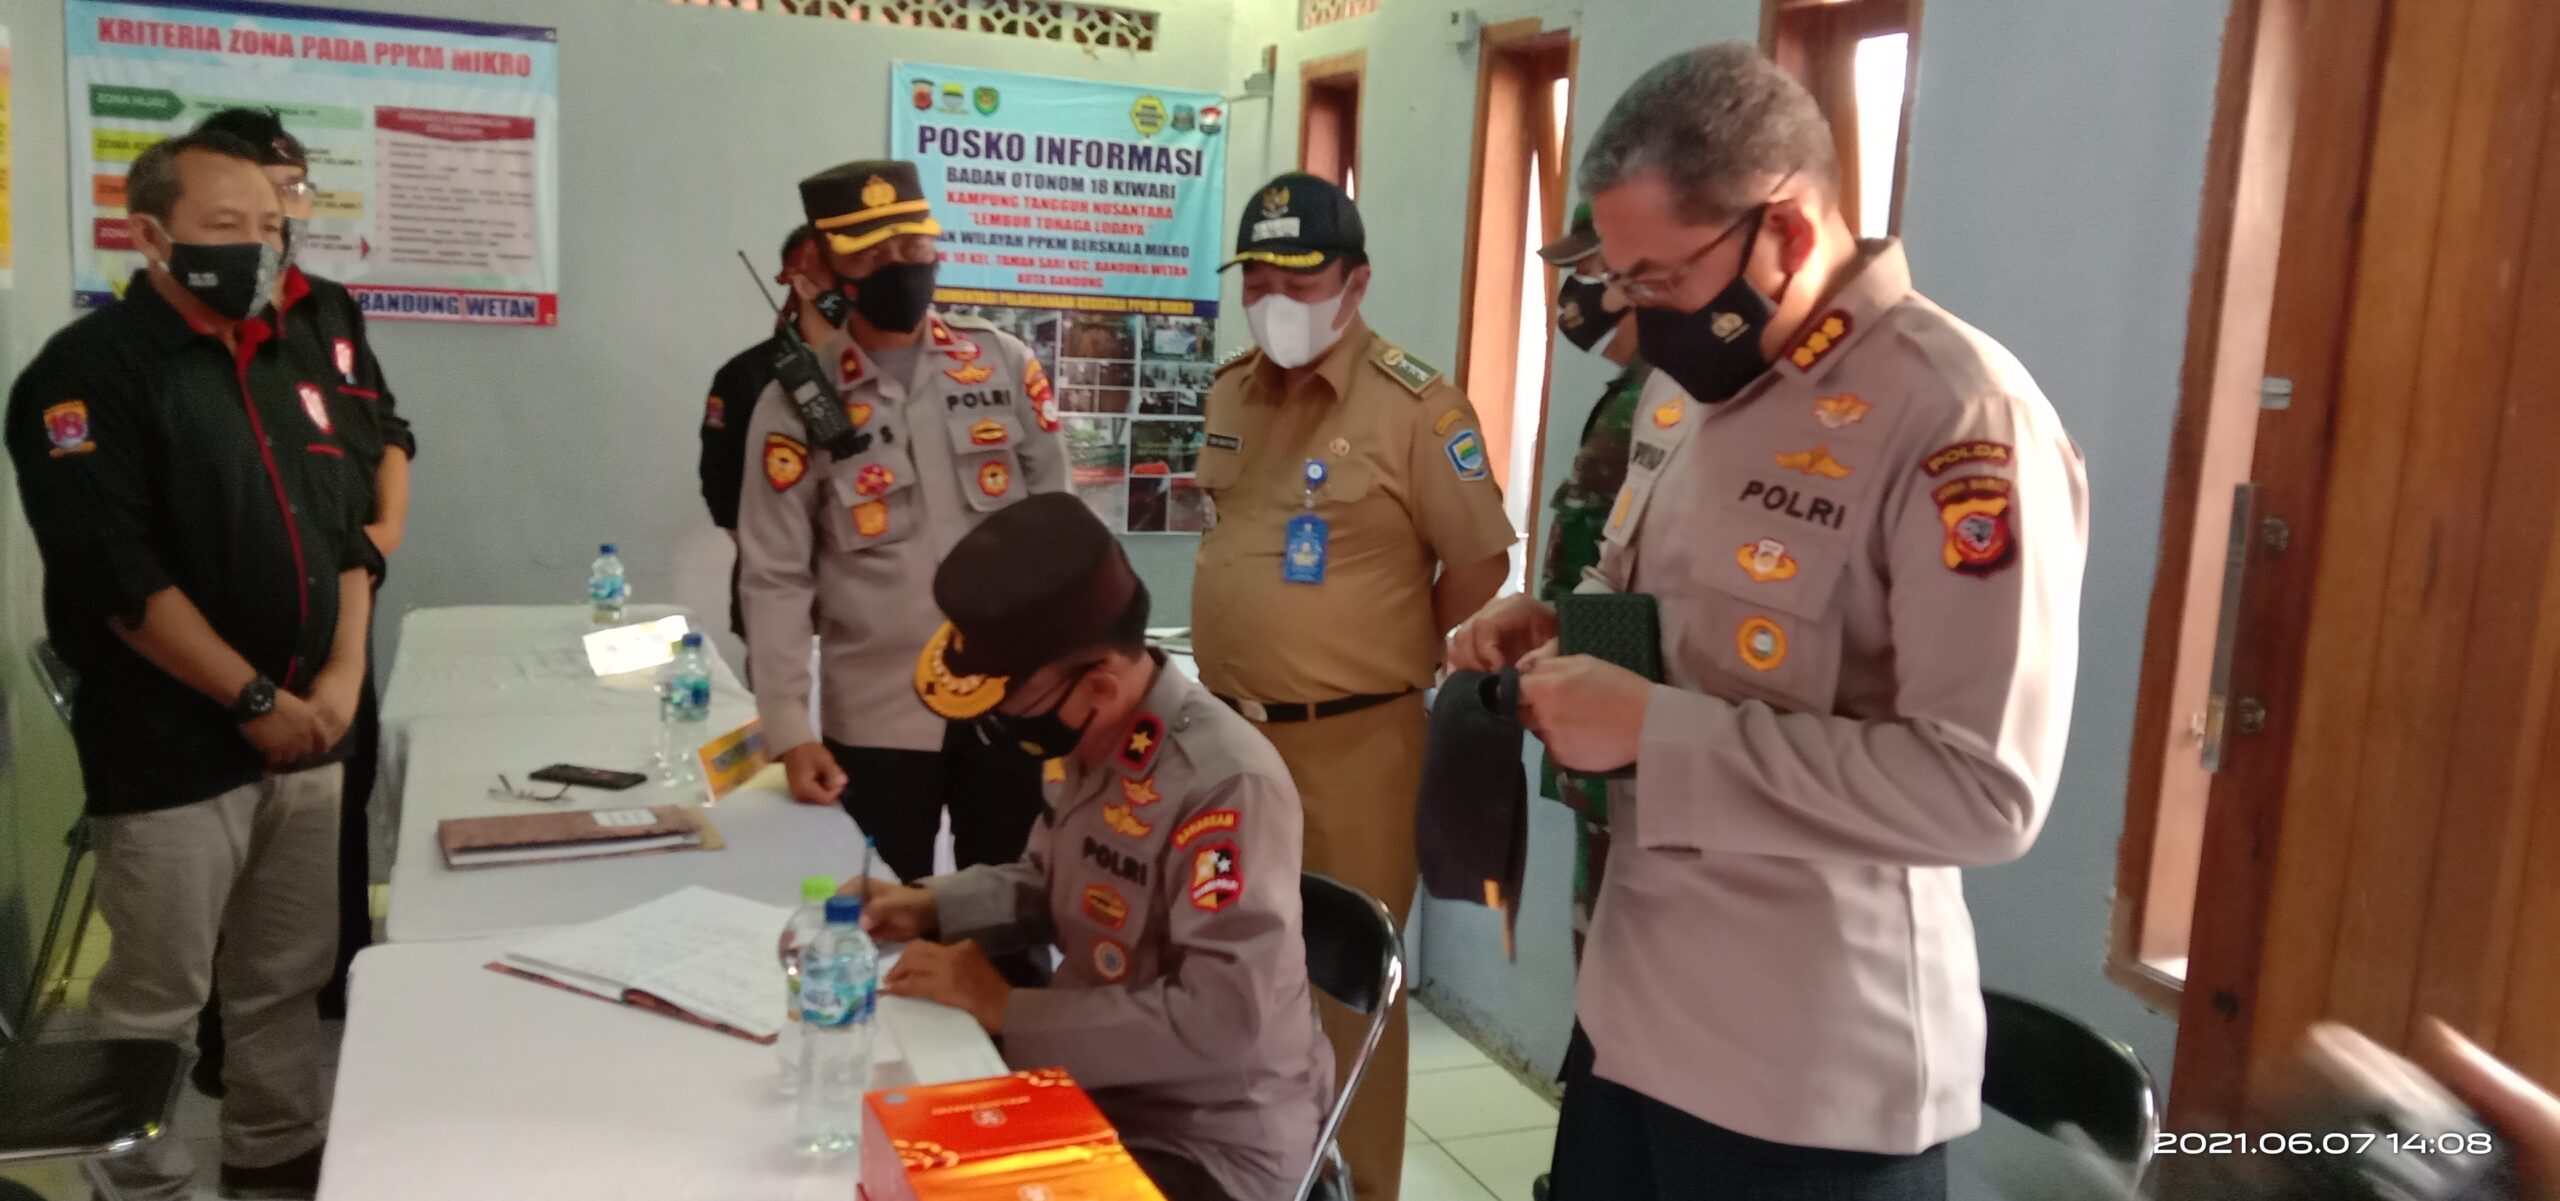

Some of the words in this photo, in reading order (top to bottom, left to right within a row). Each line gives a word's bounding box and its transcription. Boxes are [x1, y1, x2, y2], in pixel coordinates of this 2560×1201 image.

[98, 17, 222, 51] KRITERIA
[228, 29, 294, 58] ZONA
[302, 36, 367, 65] PADA
[374, 42, 444, 70] PPKM
[452, 50, 531, 77] MIKRO
[918, 125, 1025, 162] POSKO
[1035, 136, 1204, 177] INFORMASI
[947, 167, 1006, 187] BADAN
[1011, 172, 1084, 193] OTONOM
[1090, 179, 1108, 195] 18
[1113, 180, 1176, 200] KIWARI
[947, 191, 1019, 208] KAMPUNG
[1024, 196, 1089, 213] TANGGUH
[1092, 202, 1174, 219] NUSANTARA
[961, 231, 1023, 247] WILAYAH
[1028, 236, 1068, 249] PPKM
[1072, 239, 1142, 256] BERSKALA
[1145, 244, 1189, 258] MIKRO
[358, 291, 459, 315] BANDUNG
[465, 297, 536, 318] WETAN
[946, 389, 1011, 411] POLRI
[49, 412, 85, 441] 18
[1928, 444, 2008, 471] POLDA
[1739, 480, 1846, 531] POLRI
[1082, 836, 1147, 886] POLRI
